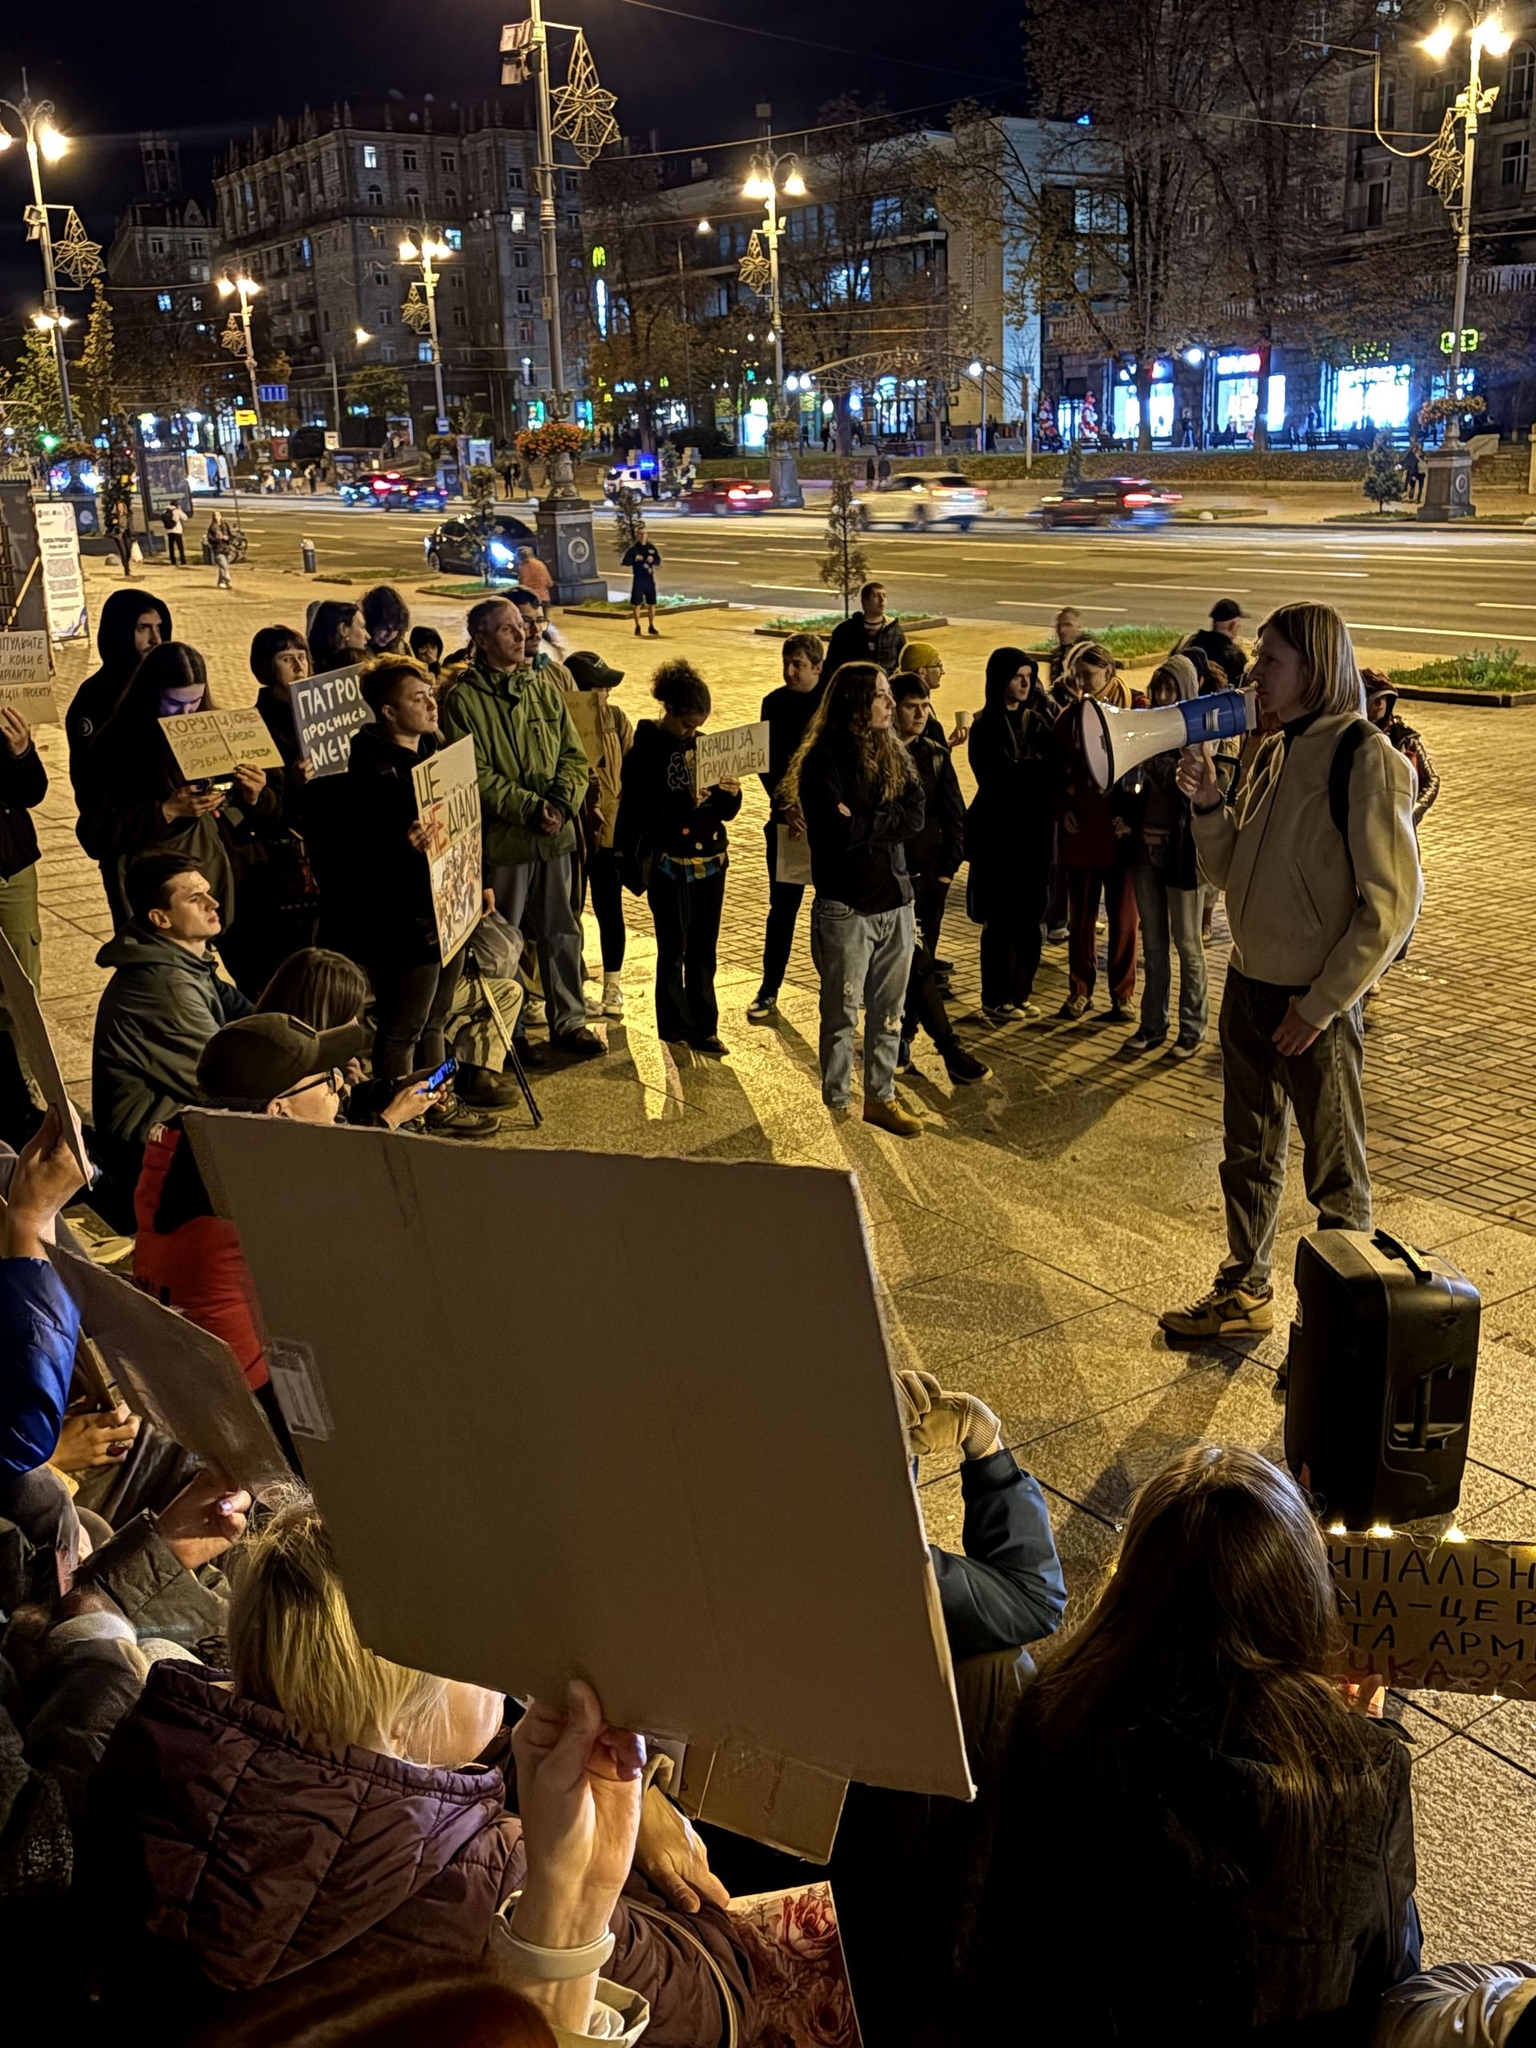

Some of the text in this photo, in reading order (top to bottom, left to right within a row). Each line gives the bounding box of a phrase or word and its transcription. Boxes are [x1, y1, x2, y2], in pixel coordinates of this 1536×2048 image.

[302, 707, 366, 745] ПРОСНИСЬ
[738, 729, 754, 749] ЗА
[1428, 1629, 1536, 1662] АРМ
